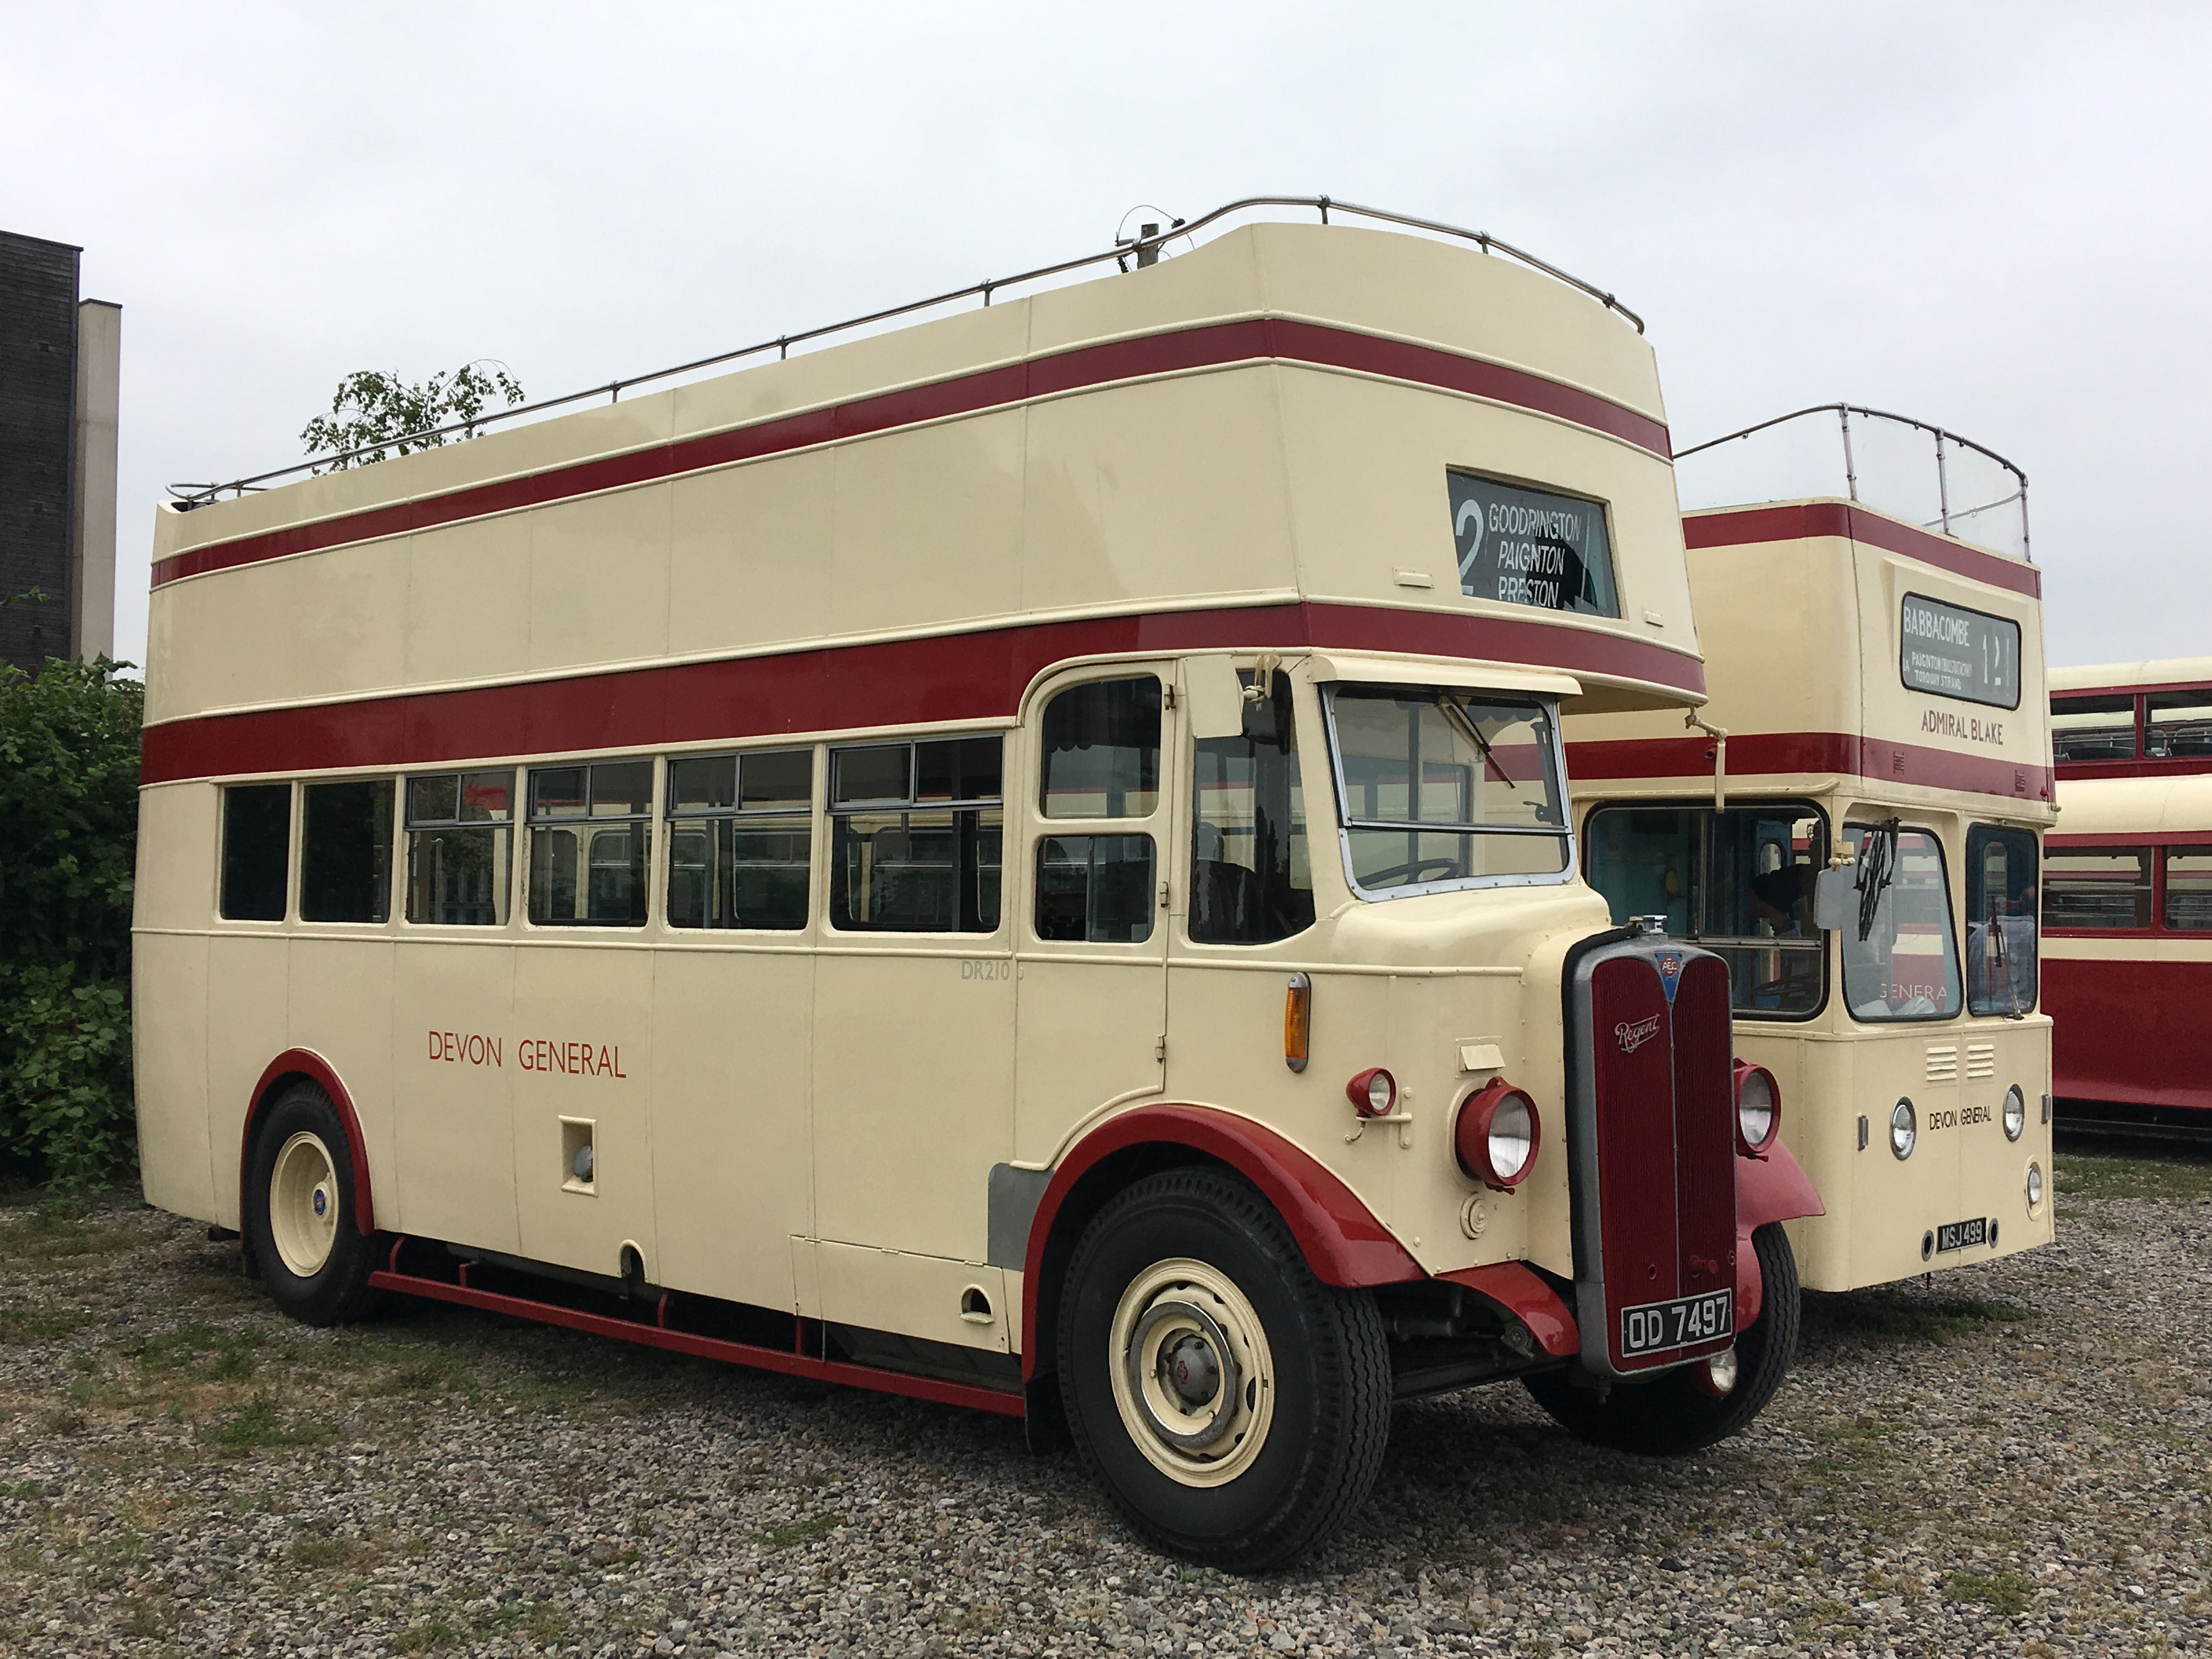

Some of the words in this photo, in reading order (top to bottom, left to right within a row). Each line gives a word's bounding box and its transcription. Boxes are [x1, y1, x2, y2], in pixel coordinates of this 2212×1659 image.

[1488, 503, 1582, 541] GOODRINGTON
[1498, 541, 1565, 575] PAIGNTON
[1498, 576, 1559, 607] PRESTON
[1904, 606, 1970, 647] BABBACOMBE
[1921, 709, 1967, 739] ADMIRAL
[1971, 718, 2004, 745] BLAKE
[961, 960, 1010, 981] DR210
[1661, 961, 1678, 971] AEC
[1880, 983, 1947, 1000] GENERA
[1615, 1014, 1660, 1053] Regent
[428, 1031, 501, 1067] DEVON
[518, 1039, 627, 1079] GENERAL
[1929, 1110, 1957, 1130] DEVON
[1961, 1105, 1991, 1125] GENERAL
[1629, 1310, 1663, 1348] OD
[1672, 1296, 1728, 1341] 7497
